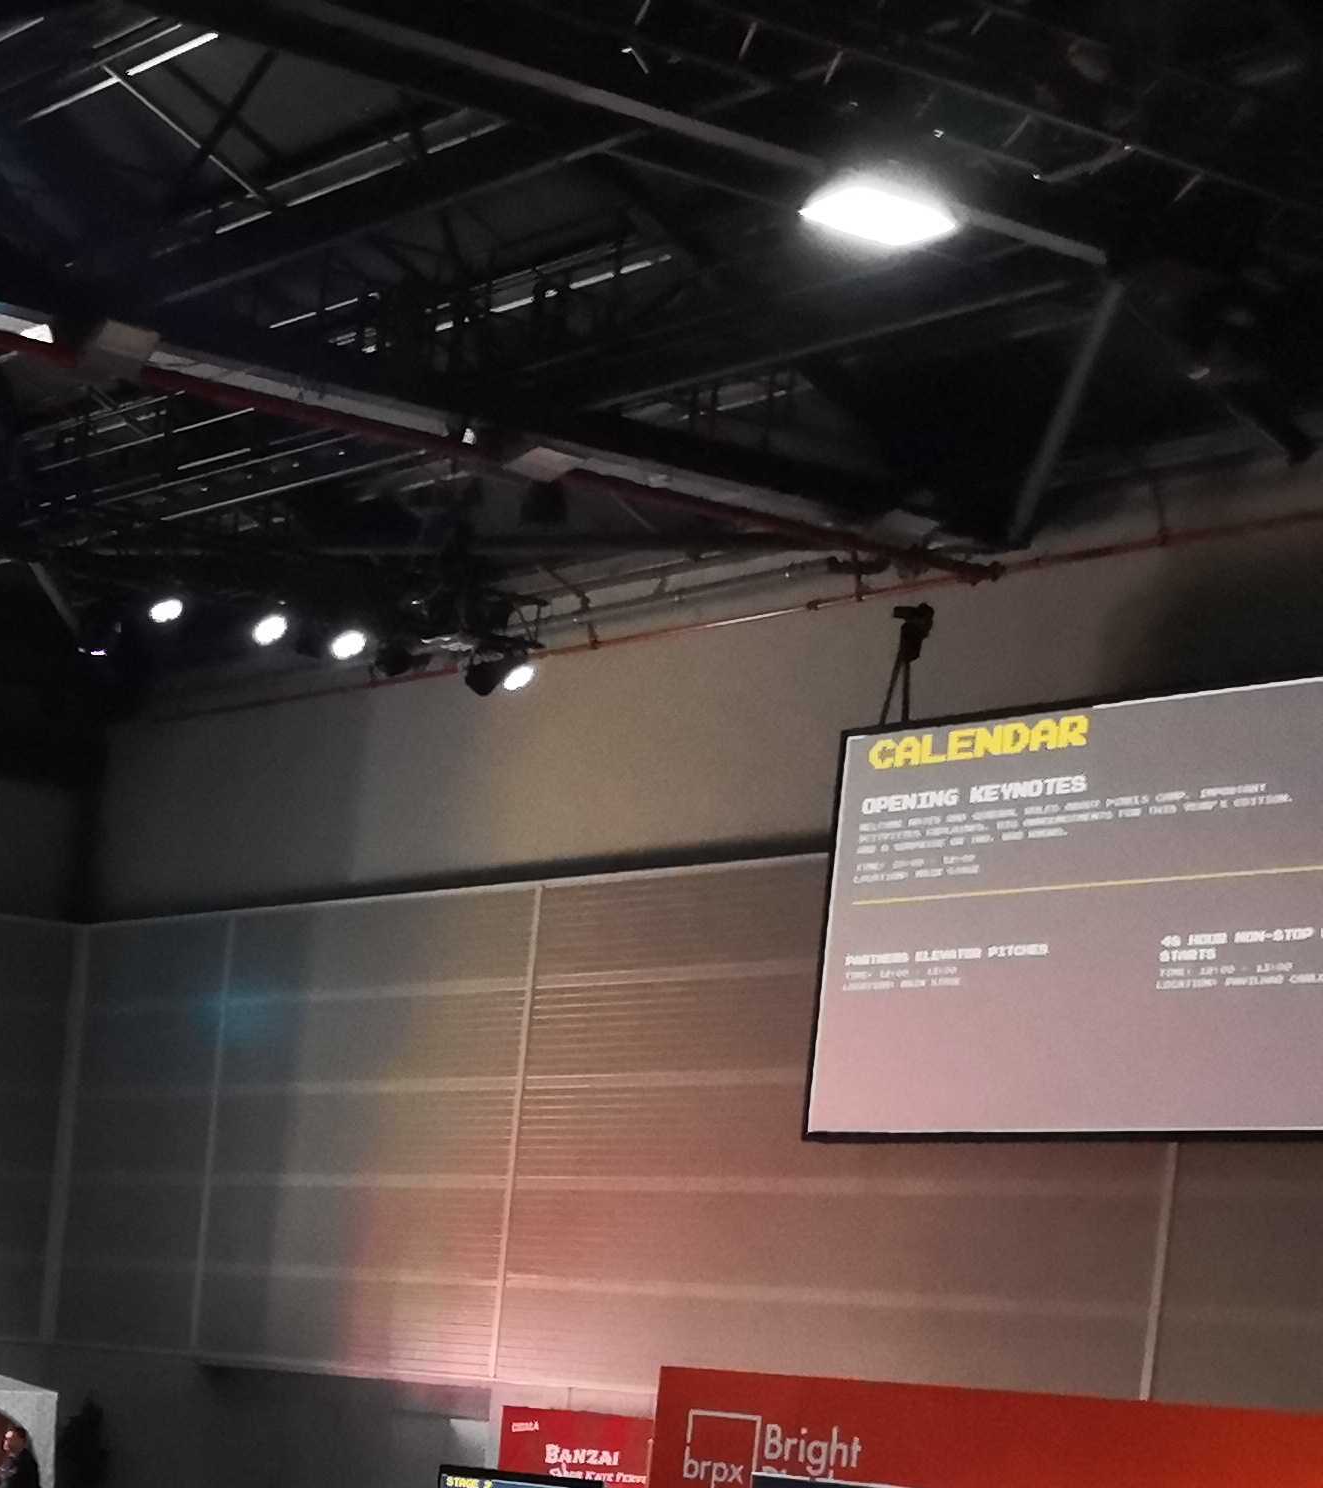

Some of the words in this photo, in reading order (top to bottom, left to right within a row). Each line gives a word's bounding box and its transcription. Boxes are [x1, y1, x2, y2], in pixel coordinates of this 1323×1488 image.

[868, 715, 1089, 769] CALENDAR
[862, 788, 959, 814] OPENING
[970, 774, 1087, 803] KEYNOTES
[545, 1444, 620, 1466] BANZAI
[763, 1424, 862, 1476] Bright
